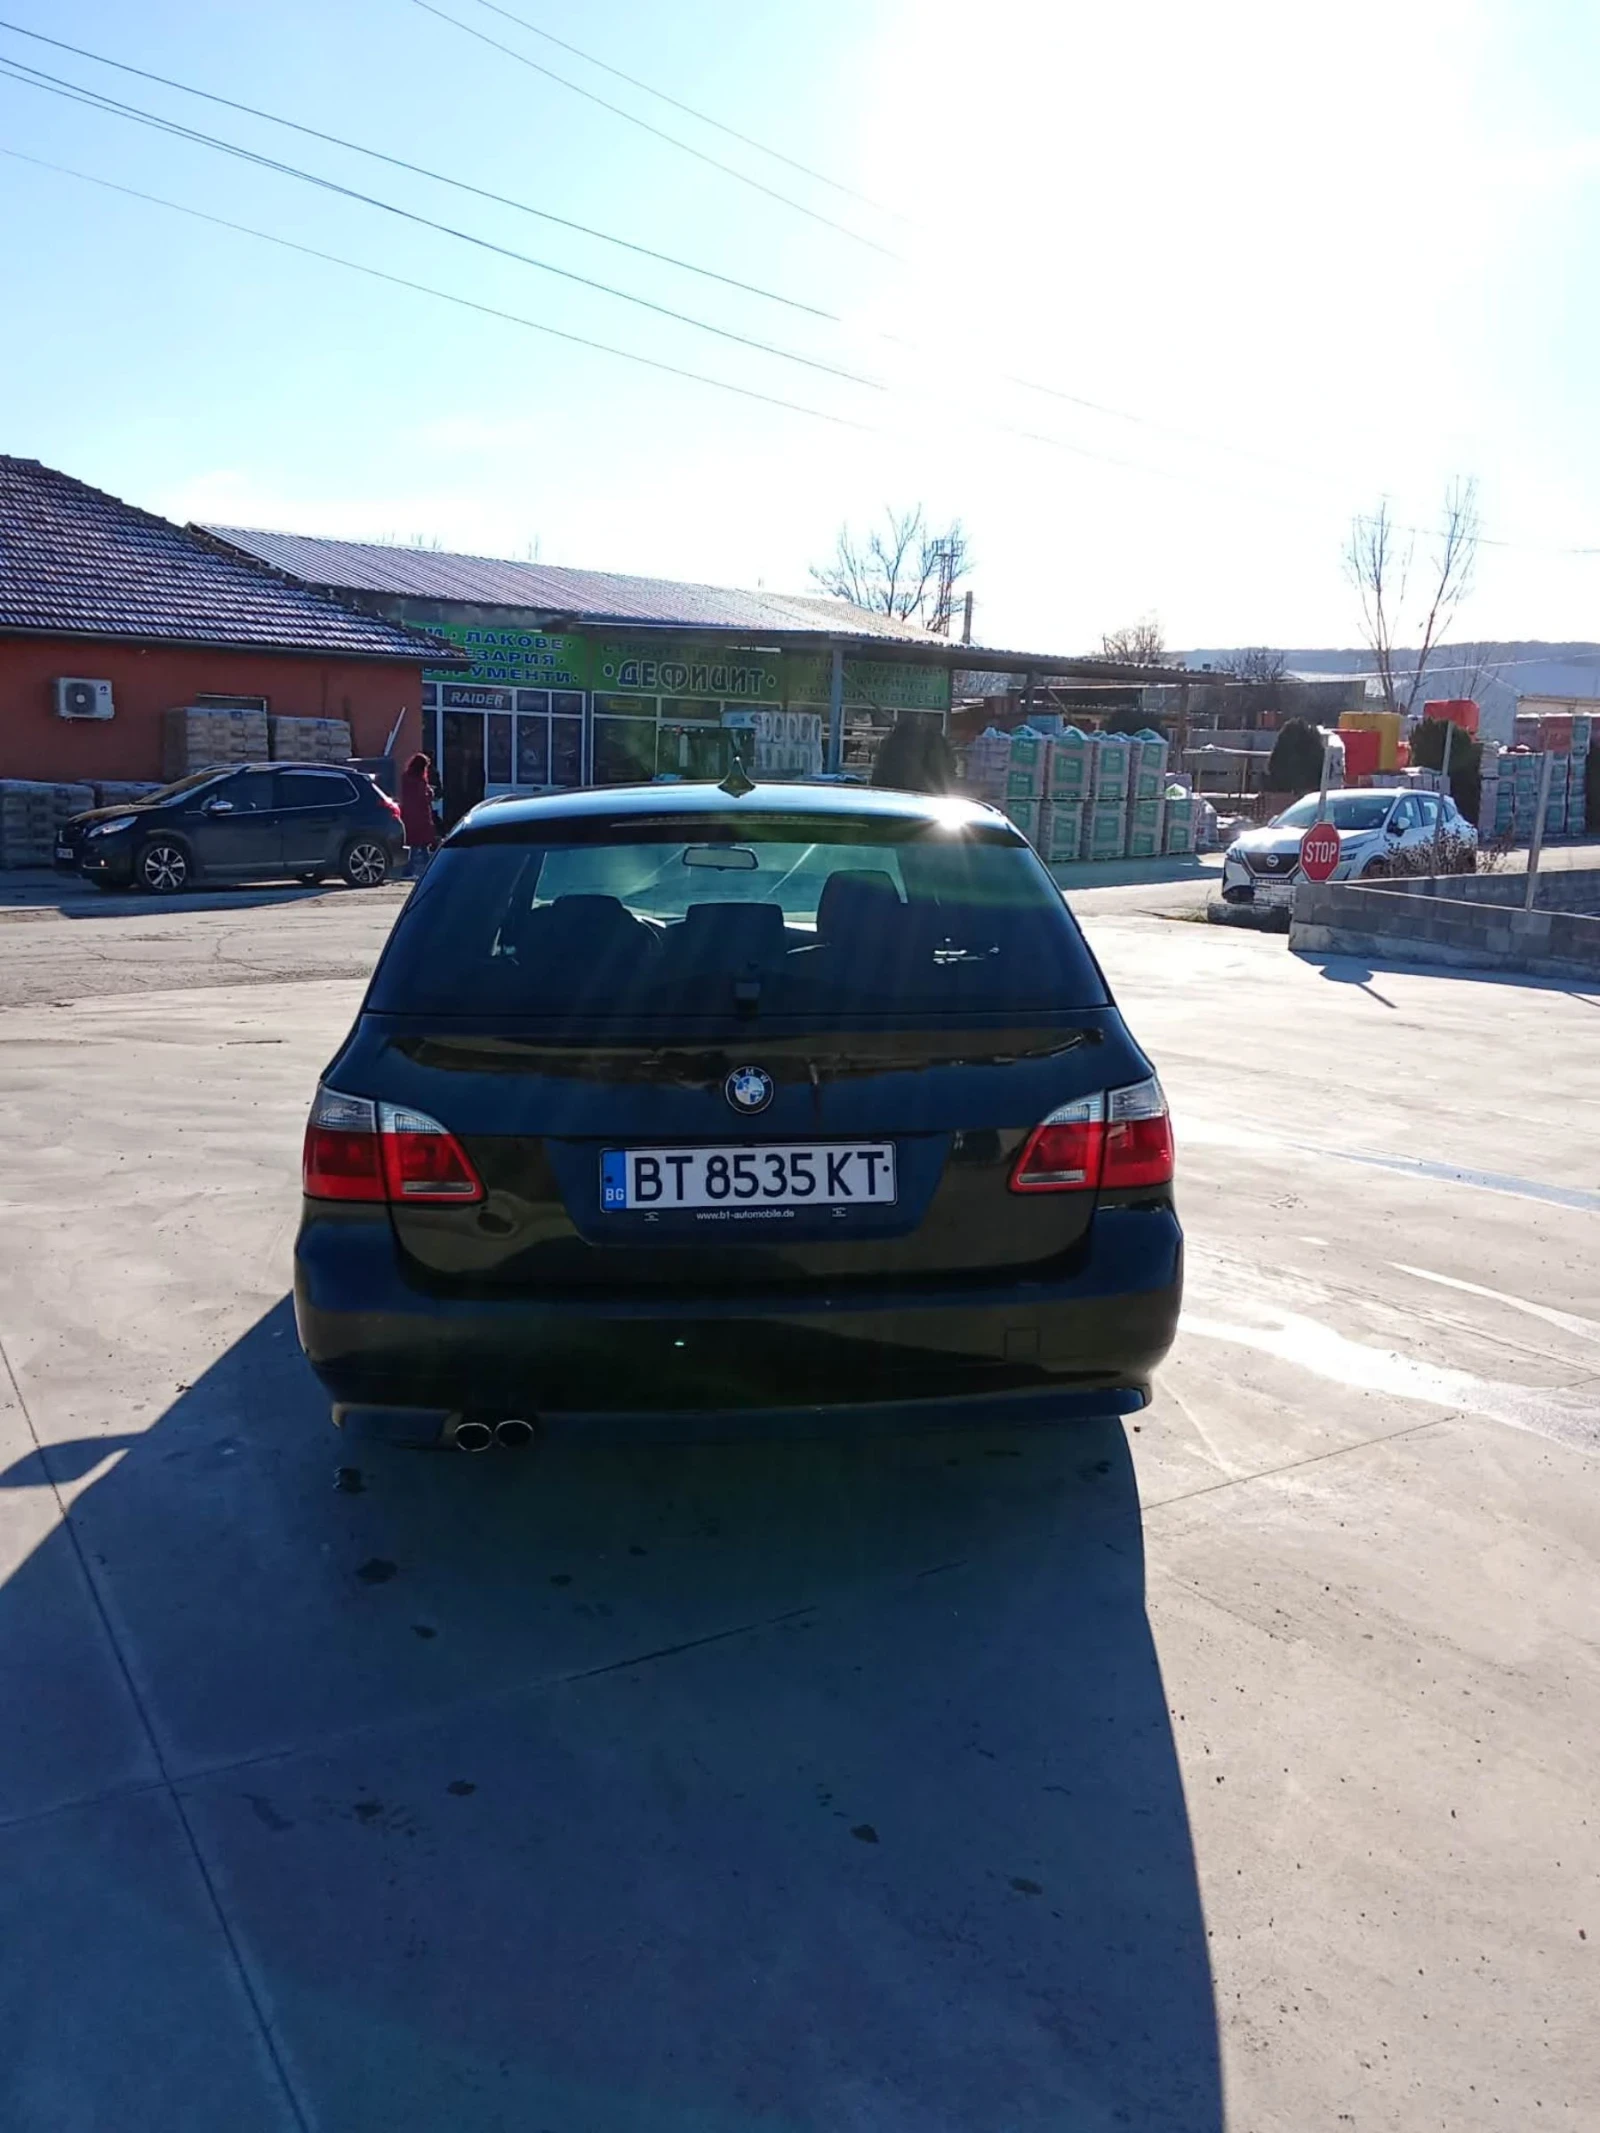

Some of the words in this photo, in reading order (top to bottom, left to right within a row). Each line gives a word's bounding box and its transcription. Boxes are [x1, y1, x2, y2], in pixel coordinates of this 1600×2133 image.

[465, 631, 565, 650] ЛАКОВЕ
[464, 648, 556, 667] ЕЗАРИЯ
[617, 659, 765, 695] ДЕФИЦИТ
[451, 692, 504, 707] RAIDER
[1304, 841, 1337, 863] STOP
[731, 1068, 769, 1083] BMW
[634, 1156, 694, 1202] BT
[705, 1153, 816, 1199] 8535
[827, 1151, 885, 1197] KT
[605, 1188, 625, 1201] BG
[696, 1209, 795, 1219] www.b1-automobile.de
